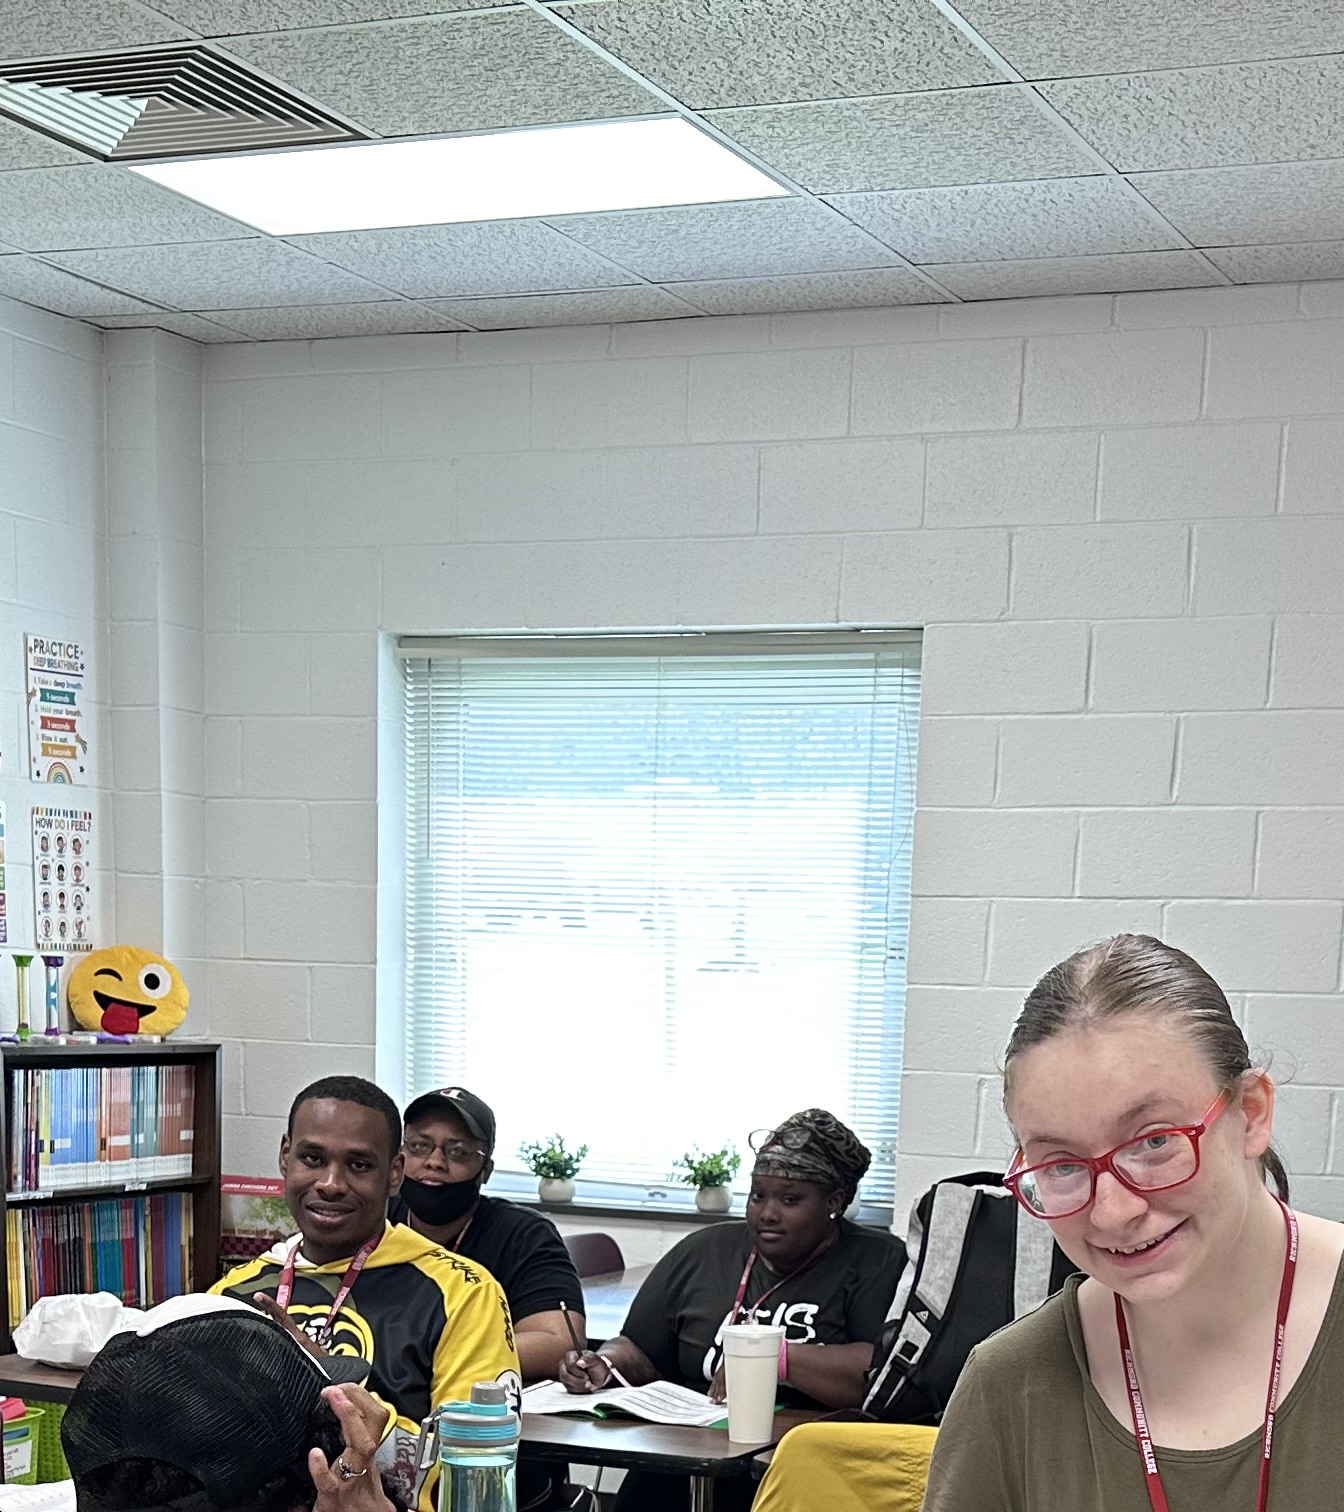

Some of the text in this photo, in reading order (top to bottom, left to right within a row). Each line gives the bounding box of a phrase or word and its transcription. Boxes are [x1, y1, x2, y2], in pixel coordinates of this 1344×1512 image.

[33, 638, 79, 659] PRACTICE
[35, 818, 91, 832] HOW DO FEEL?
[1132, 1391, 1158, 1474] COMMUNITY COLLEGE
